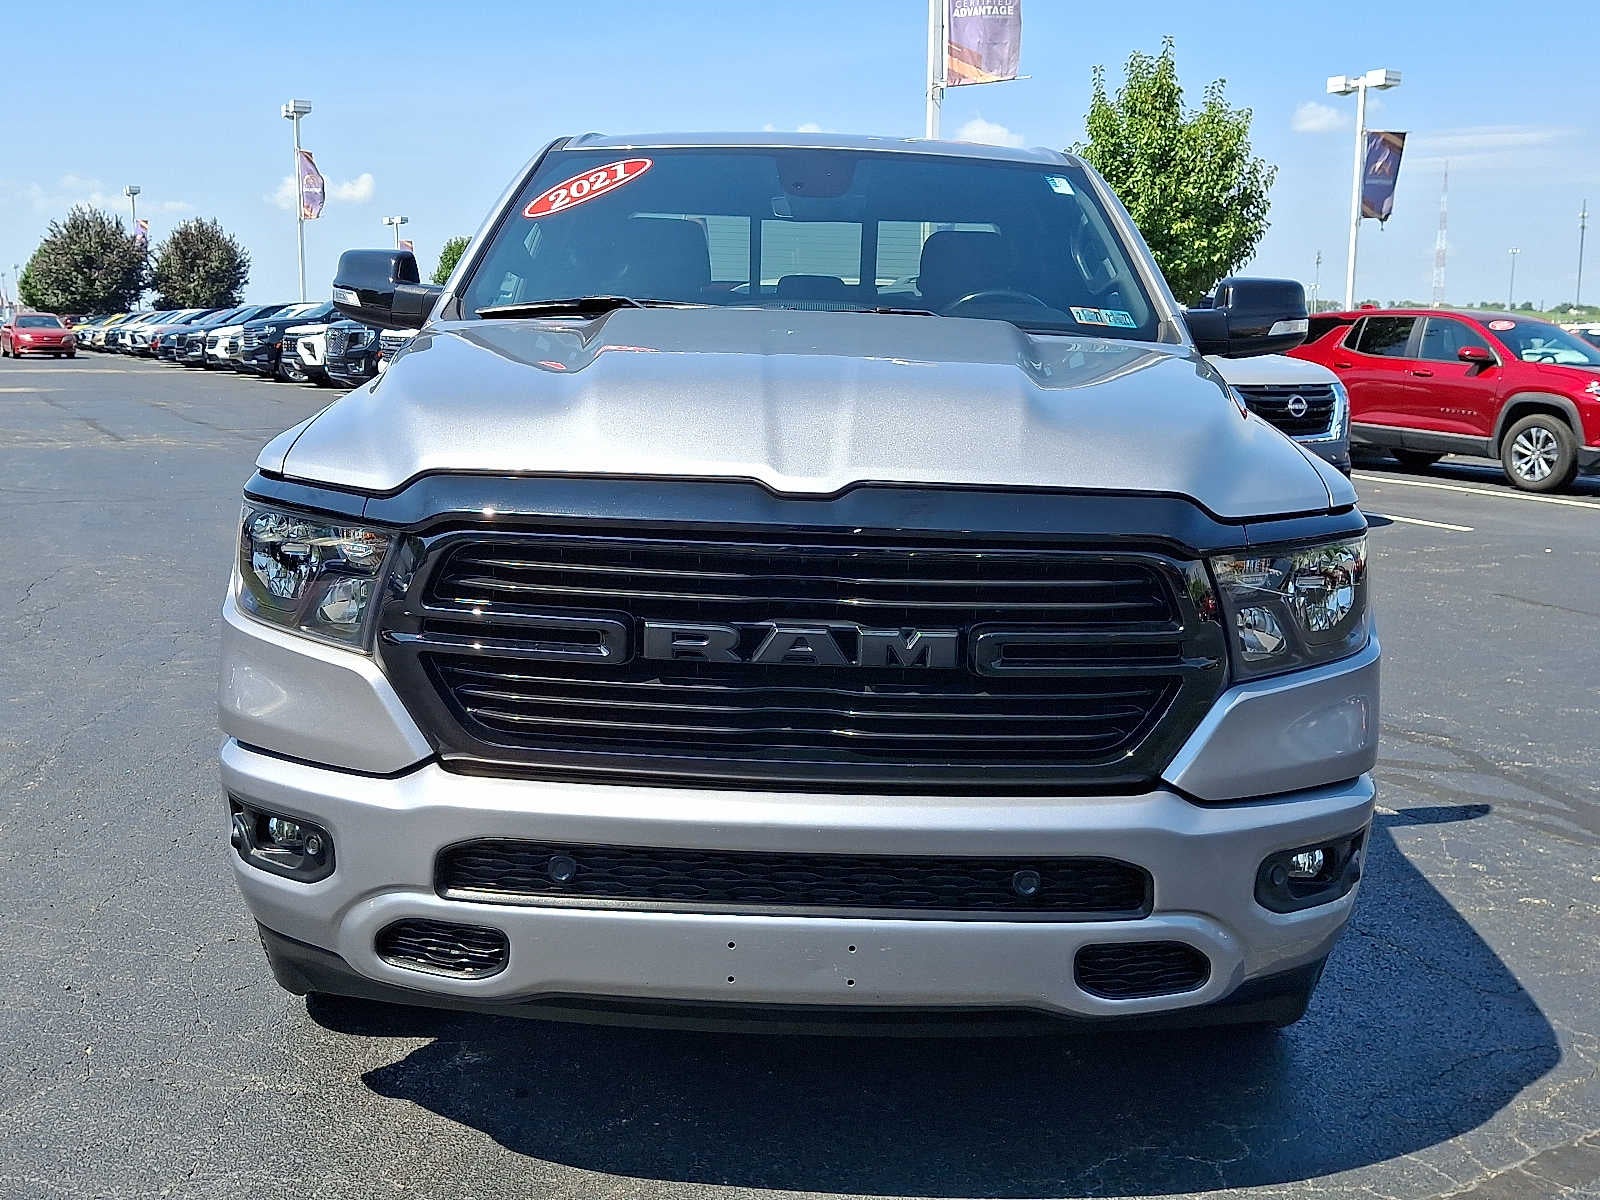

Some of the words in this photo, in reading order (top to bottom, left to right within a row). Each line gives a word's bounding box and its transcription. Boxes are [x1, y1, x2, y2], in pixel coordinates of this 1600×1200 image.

[952, 5, 1014, 18] ADVANTAGE
[548, 162, 631, 210] 2021
[643, 619, 958, 668] RAM
